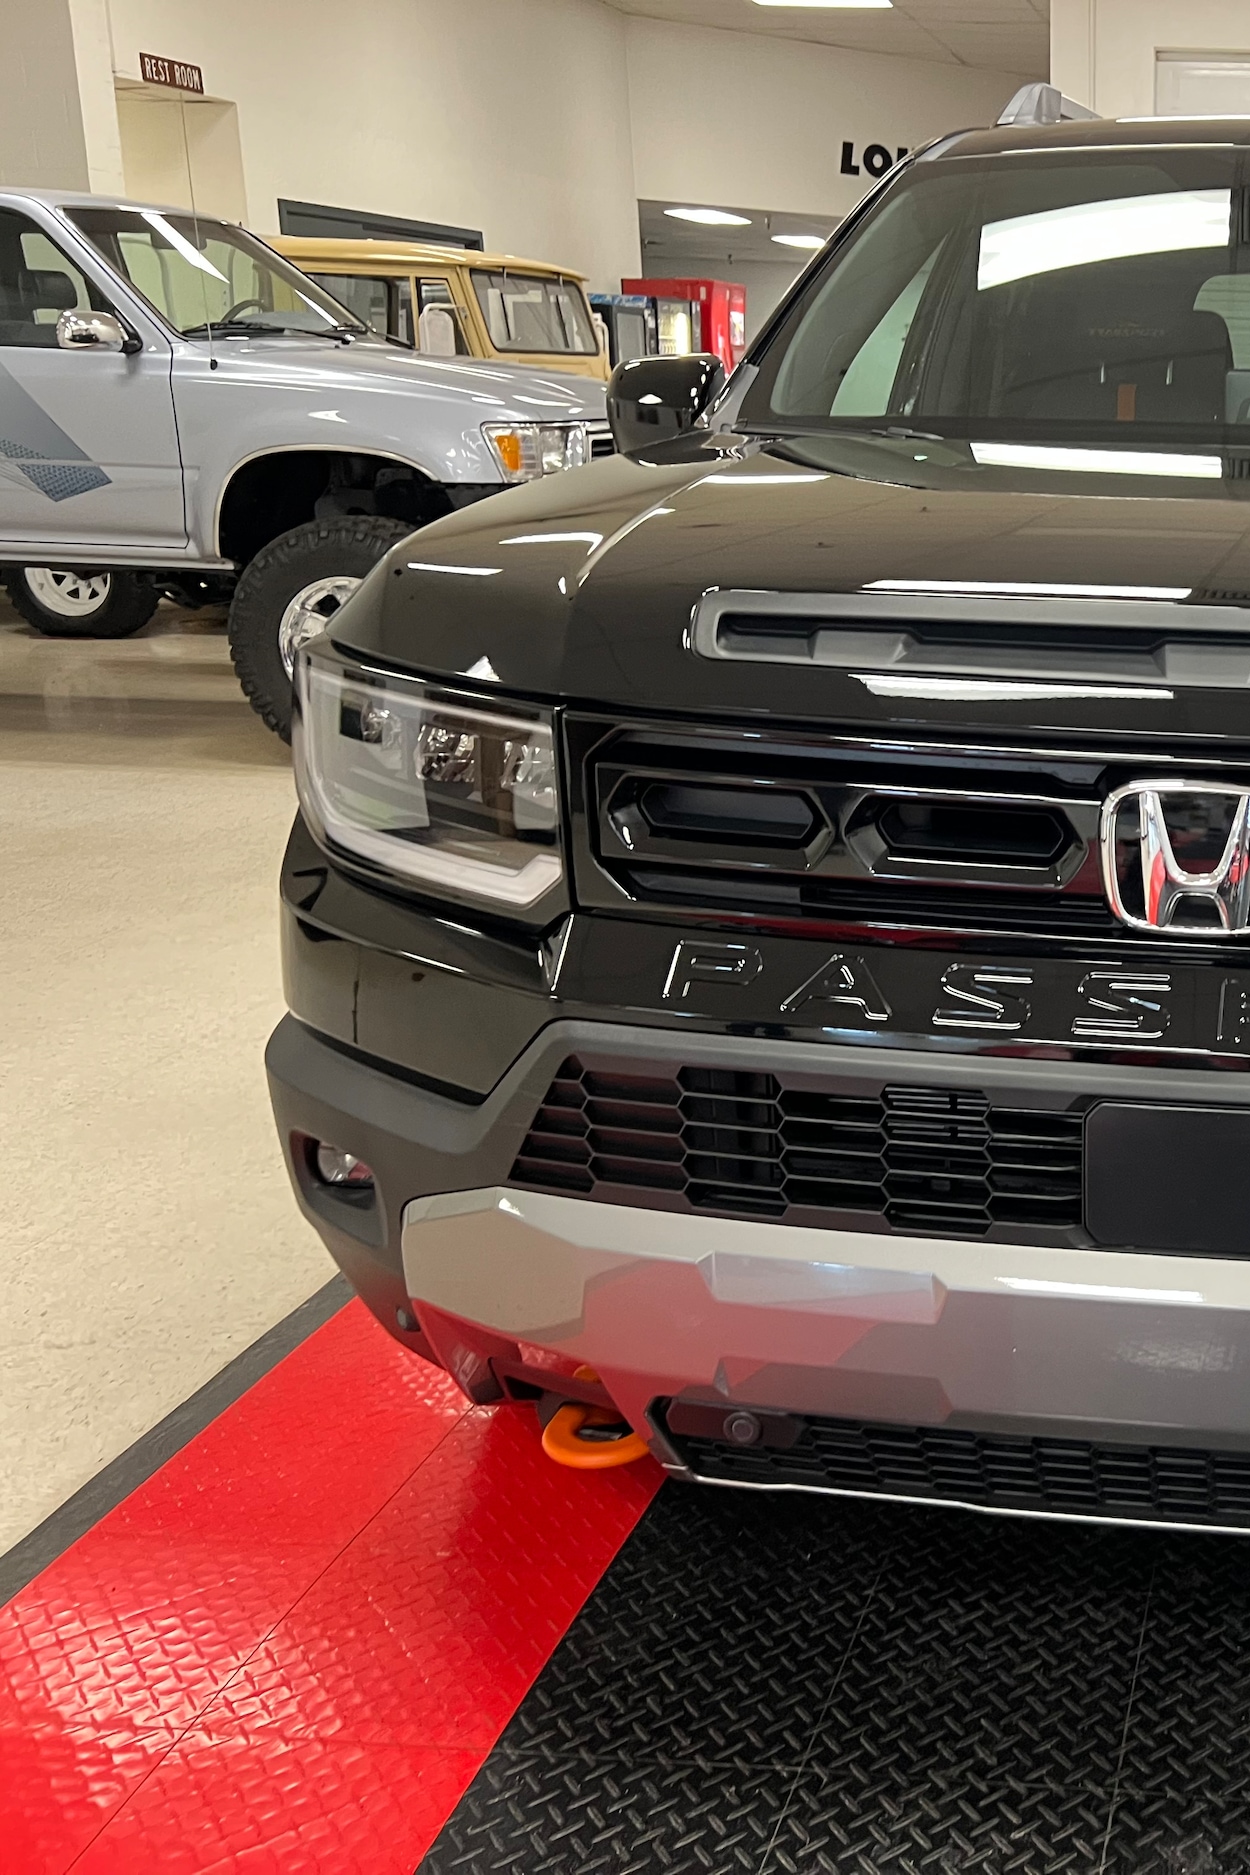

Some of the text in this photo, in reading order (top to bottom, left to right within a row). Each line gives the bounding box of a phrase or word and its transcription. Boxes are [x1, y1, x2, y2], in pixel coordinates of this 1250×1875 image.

[144, 57, 201, 90] REST ROOM
[840, 141, 915, 178] LO
